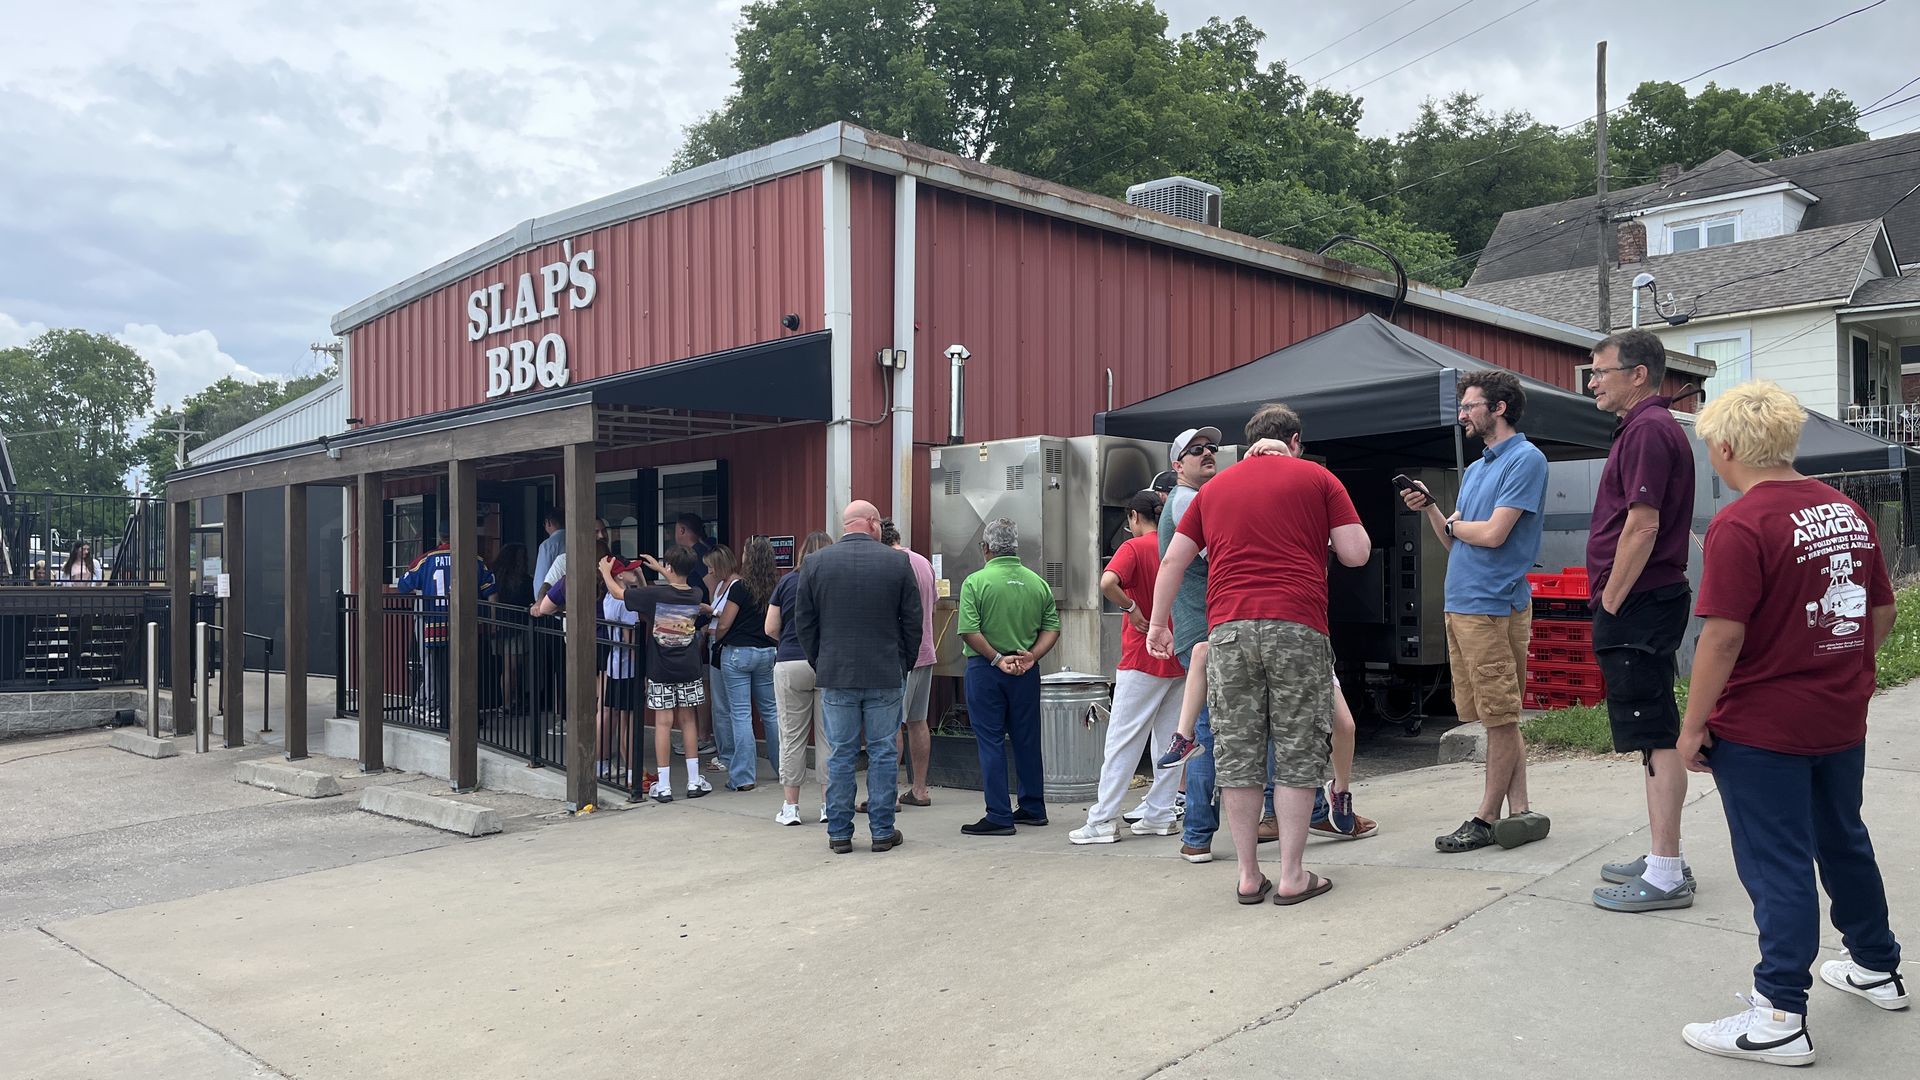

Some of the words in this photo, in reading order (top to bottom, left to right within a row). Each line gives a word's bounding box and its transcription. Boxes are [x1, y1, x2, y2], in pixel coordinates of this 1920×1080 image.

[467, 239, 597, 342] SLAP'S
[486, 332, 570, 398] BBQ
[1789, 503, 1858, 526] UNDER
[1793, 517, 1869, 547] ARMOUR
[1796, 555, 1806, 563] IN
[1831, 559, 1850, 571] UA
